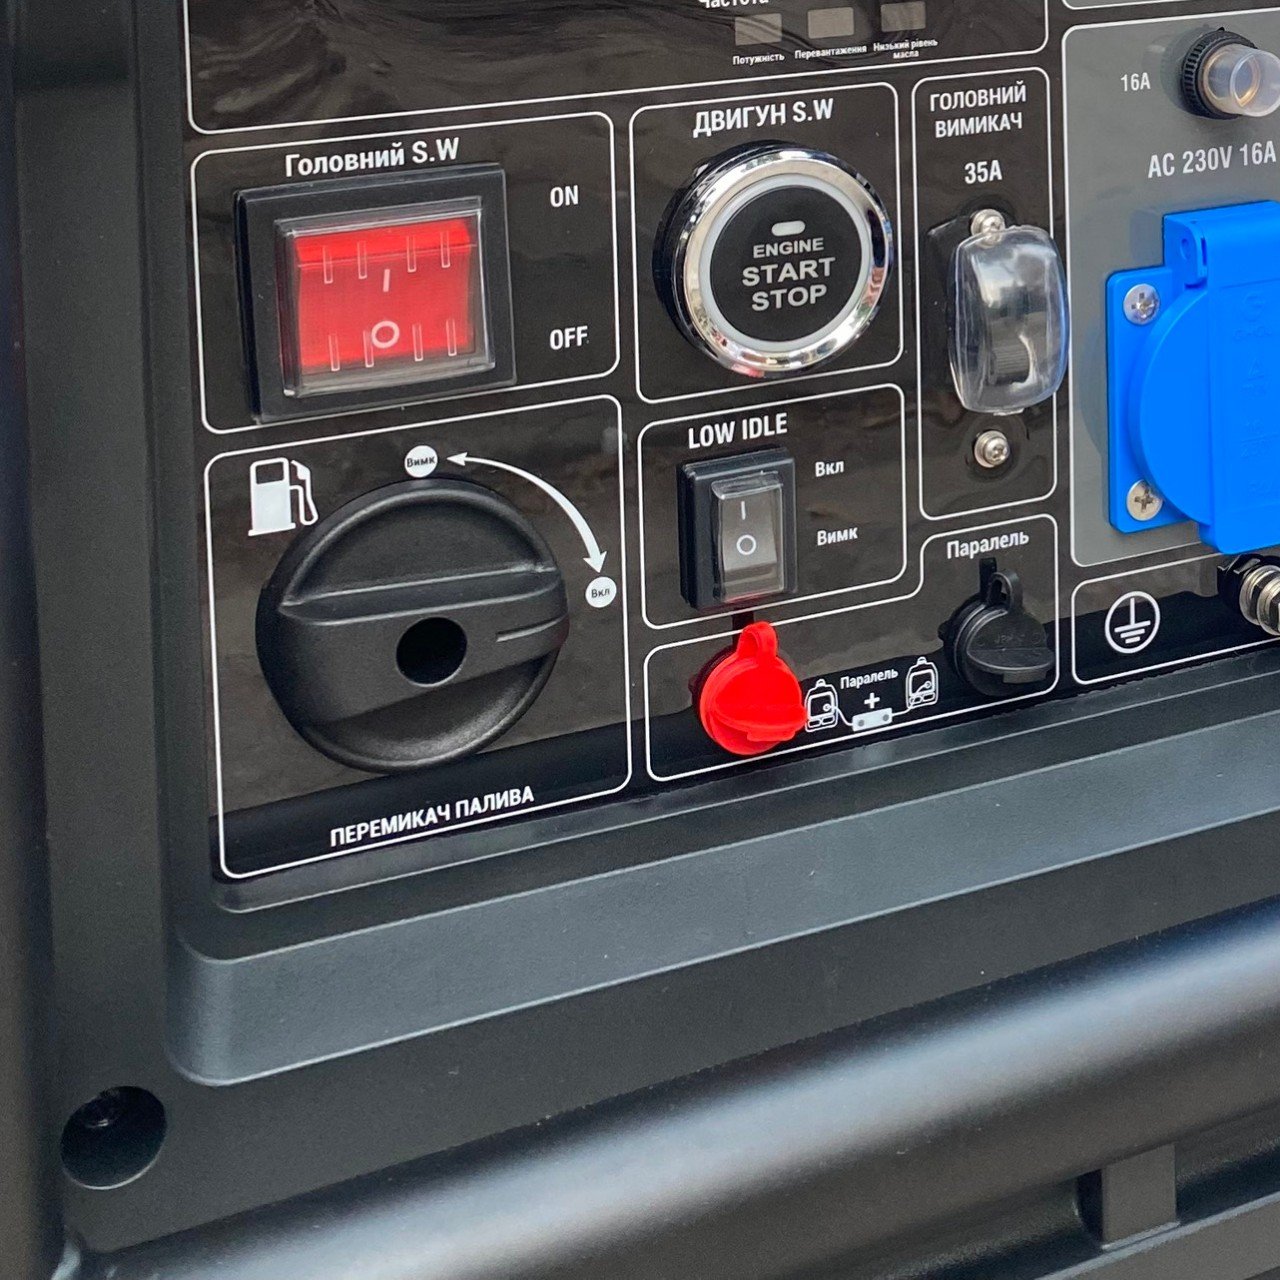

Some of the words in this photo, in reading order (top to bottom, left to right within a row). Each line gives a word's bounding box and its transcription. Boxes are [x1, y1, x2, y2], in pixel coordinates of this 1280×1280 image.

[794, 43, 867, 61] Перевантаження
[873, 40, 909, 54] Низький
[911, 37, 938, 51] рівень
[893, 48, 919, 59] масла
[732, 51, 785, 66] Потужність
[1120, 72, 1151, 92] 16A
[929, 80, 1027, 112] ГОЛОВНИЙ
[692, 102, 787, 138] ДВИГУН
[792, 98, 834, 122] S.W
[935, 111, 1023, 139] ВИМИКАЧ
[285, 140, 406, 177] Головний
[411, 137, 460, 164] S.W
[1147, 151, 1176, 179] AC
[1182, 145, 1233, 175] 230V
[1239, 140, 1277, 167] 16A
[964, 160, 1003, 184] 35A
[549, 185, 579, 208] ON
[752, 237, 824, 259] ENGINE
[741, 257, 836, 287] START
[751, 284, 828, 312] STOP
[549, 325, 588, 350] OFF
[687, 420, 735, 450] LOW
[741, 412, 789, 440] IDLE
[406, 454, 436, 469] Вимк
[815, 459, 845, 477] Вкл
[816, 526, 859, 546] Вимк
[945, 529, 1030, 559] Паралель
[591, 586, 611, 598] Вкл
[839, 667, 899, 690] Паралель
[330, 800, 452, 848] ПЕРЕМИКАЧ
[455, 785, 535, 819] ПАЛИВА
